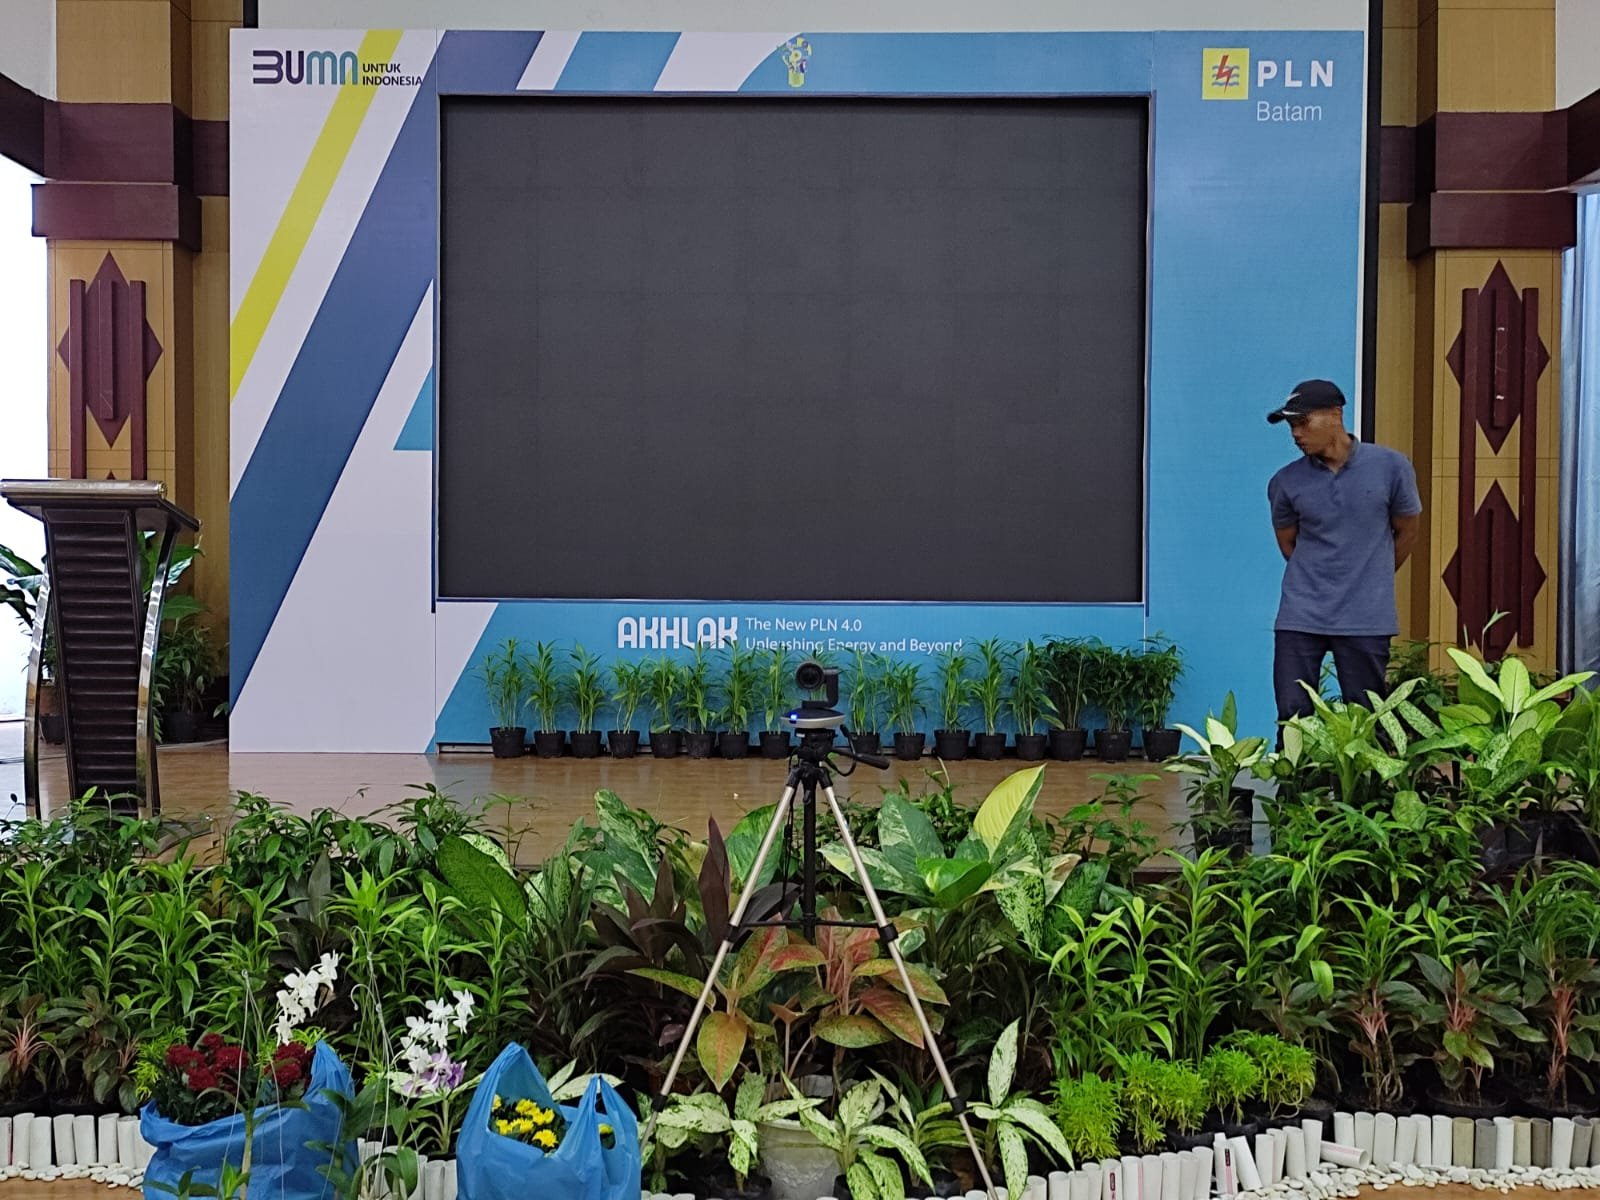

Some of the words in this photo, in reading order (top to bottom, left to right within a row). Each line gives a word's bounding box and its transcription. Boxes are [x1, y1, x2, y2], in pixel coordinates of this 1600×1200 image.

[362, 63, 401, 73] UNTUK
[1257, 60, 1334, 88] PLN
[362, 76, 423, 86] INDONESIA
[1256, 101, 1323, 122] Batam
[745, 617, 772, 631] The
[775, 618, 807, 631] New
[809, 618, 837, 631] PLN
[840, 619, 863, 632] 4.0
[617, 616, 738, 649] AKHLAK
[879, 639, 906, 652] and
